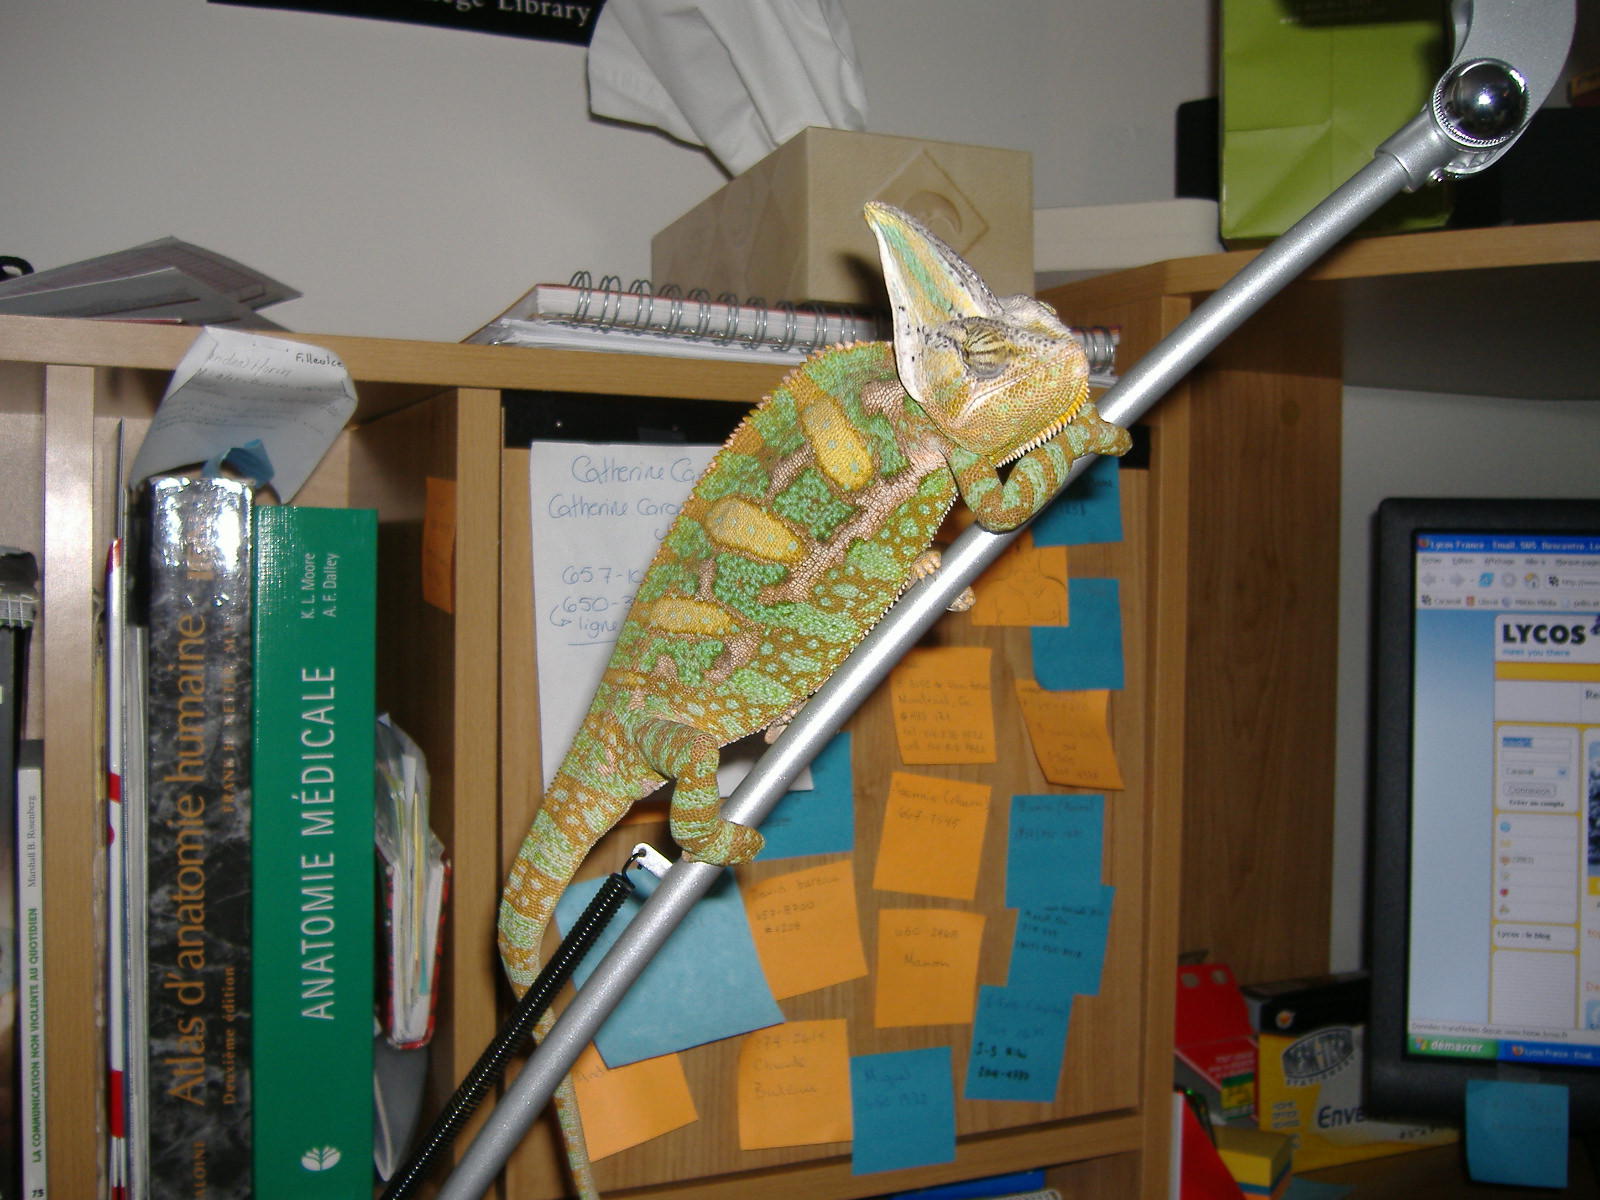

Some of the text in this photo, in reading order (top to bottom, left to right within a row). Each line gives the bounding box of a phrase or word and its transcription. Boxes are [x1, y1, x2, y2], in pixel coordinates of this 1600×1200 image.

[498, 0, 590, 27] Library
[571, 455, 696, 484] Catherine Ca
[549, 493, 627, 519] Catherine
[1456, 541, 1485, 550] France
[302, 553, 316, 619] K. L. Moore
[323, 553, 339, 617] A. F. Dalley
[1502, 623, 1586, 646] LYCOS
[1502, 648, 1571, 658] meet you there
[162, 613, 206, 783] humaine
[221, 757, 235, 813] FRANK
[25, 795, 37, 888] Marshall B. Rosenberg
[291, 666, 335, 1020] ANATOMIE MÉDICALE
[163, 794, 206, 1006] d'anatomie
[26, 908, 41, 1164] LA COMMUNICATION NON VIOLENTE AU QUOTIDIEN
[162, 1015, 206, 1106] Atlas
[220, 966, 237, 1104] Deuxième édition
[1431, 1039, 1484, 1053] démarrer
